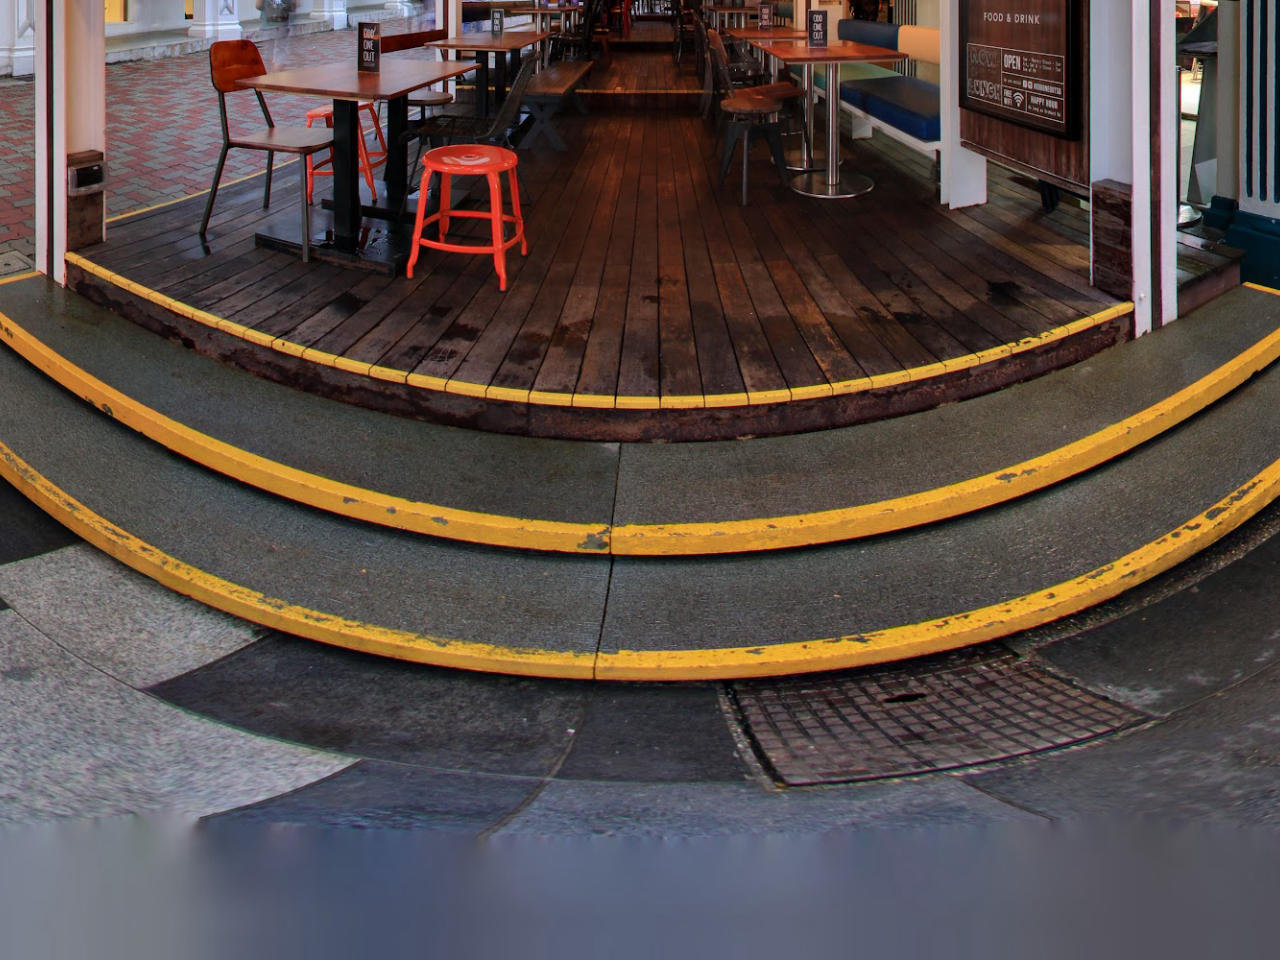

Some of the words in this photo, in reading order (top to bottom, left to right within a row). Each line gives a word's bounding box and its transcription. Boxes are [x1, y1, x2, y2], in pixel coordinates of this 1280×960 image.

[983, 11, 1004, 23] FOOD
[1006, 13, 1012, 23] &
[1014, 13, 1041, 25] DRINK
[1004, 54, 1020, 70] OPEN
